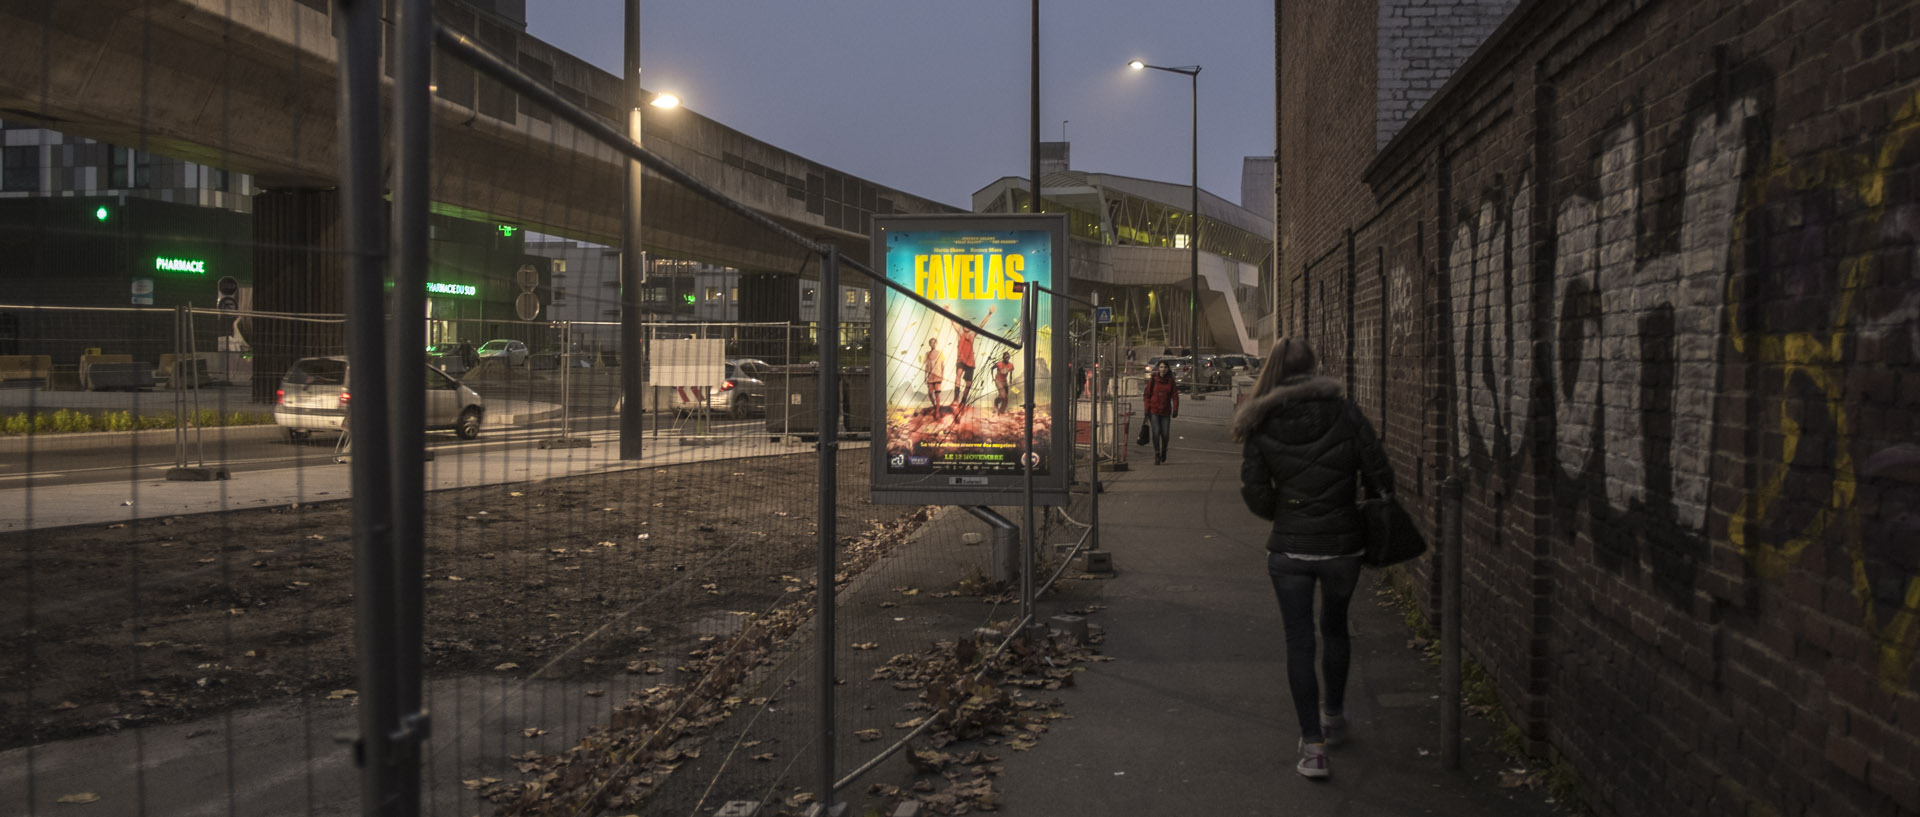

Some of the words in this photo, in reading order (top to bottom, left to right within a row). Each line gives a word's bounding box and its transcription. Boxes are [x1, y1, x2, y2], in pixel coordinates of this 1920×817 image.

[155, 257, 205, 273] PHARMACIE
[914, 253, 1025, 300] FAVELAS
[456, 285, 464, 295] DU
[464, 285, 476, 296] SUD
[963, 454, 1004, 462] NOVEMBRE
